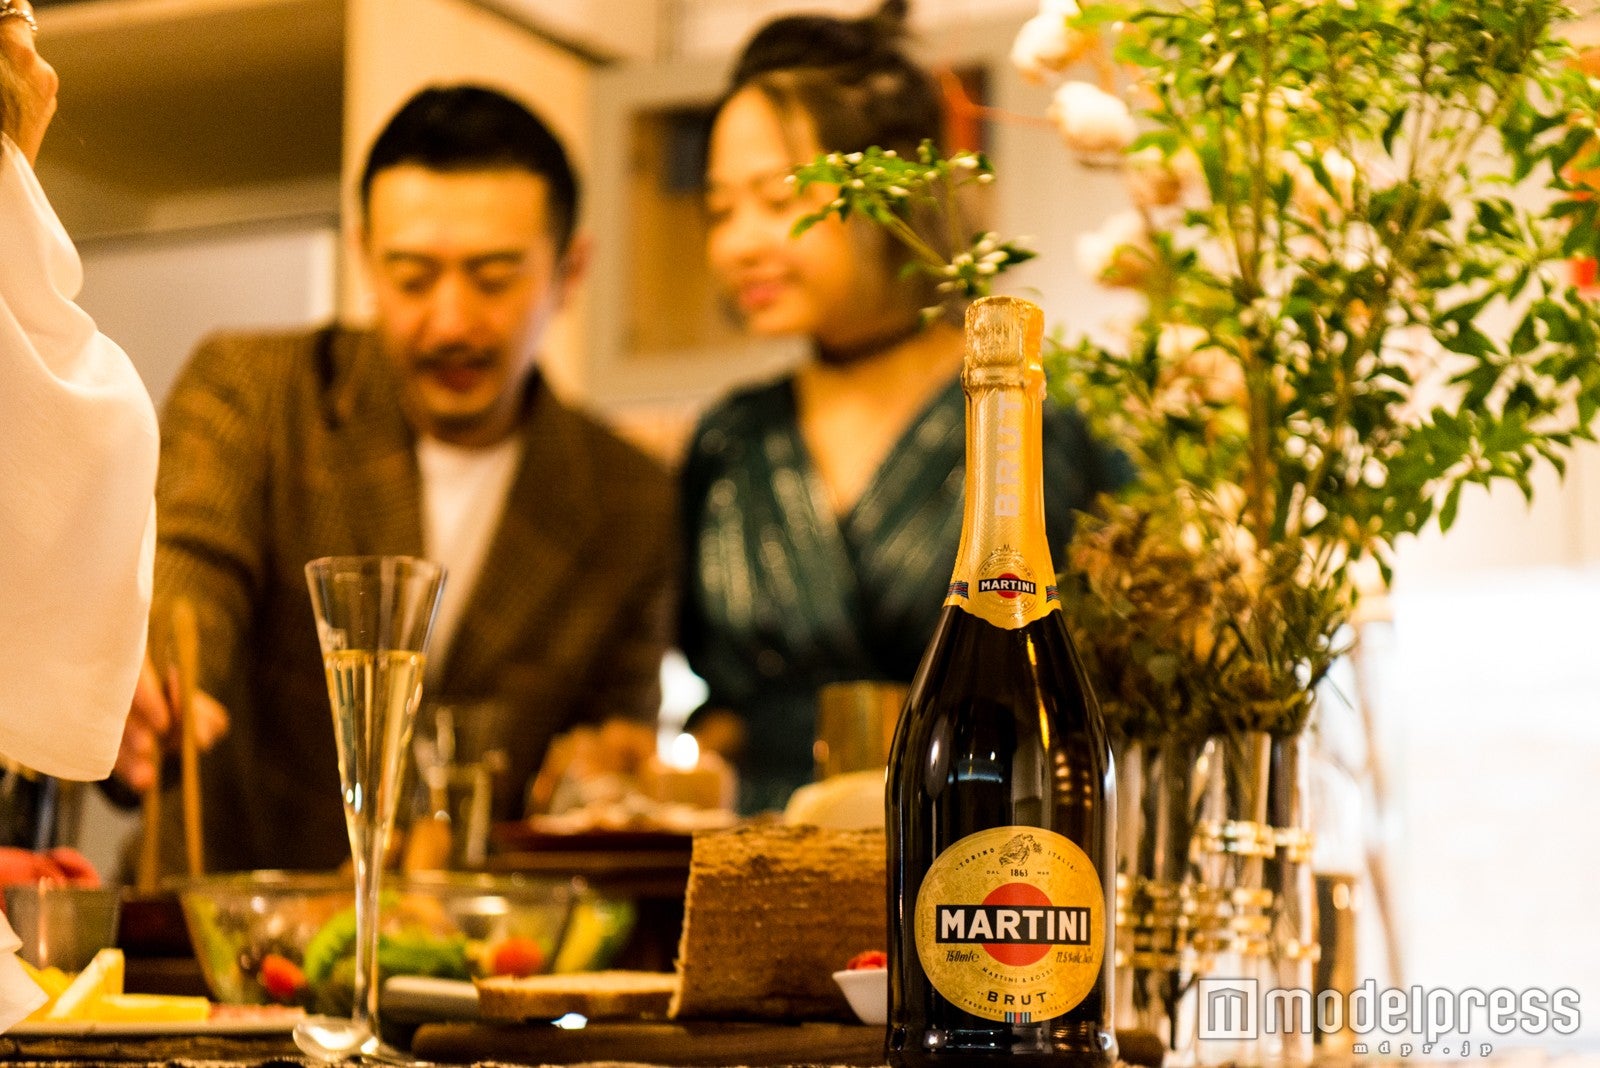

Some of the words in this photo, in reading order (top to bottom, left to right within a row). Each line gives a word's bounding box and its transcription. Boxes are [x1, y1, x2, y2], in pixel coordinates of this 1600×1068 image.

[995, 391, 1022, 517] BRUT
[981, 580, 1035, 593] MARTINI
[1010, 868, 1029, 878] 1863
[941, 909, 1087, 941] MARTINI
[987, 991, 1047, 1005] BRUT
